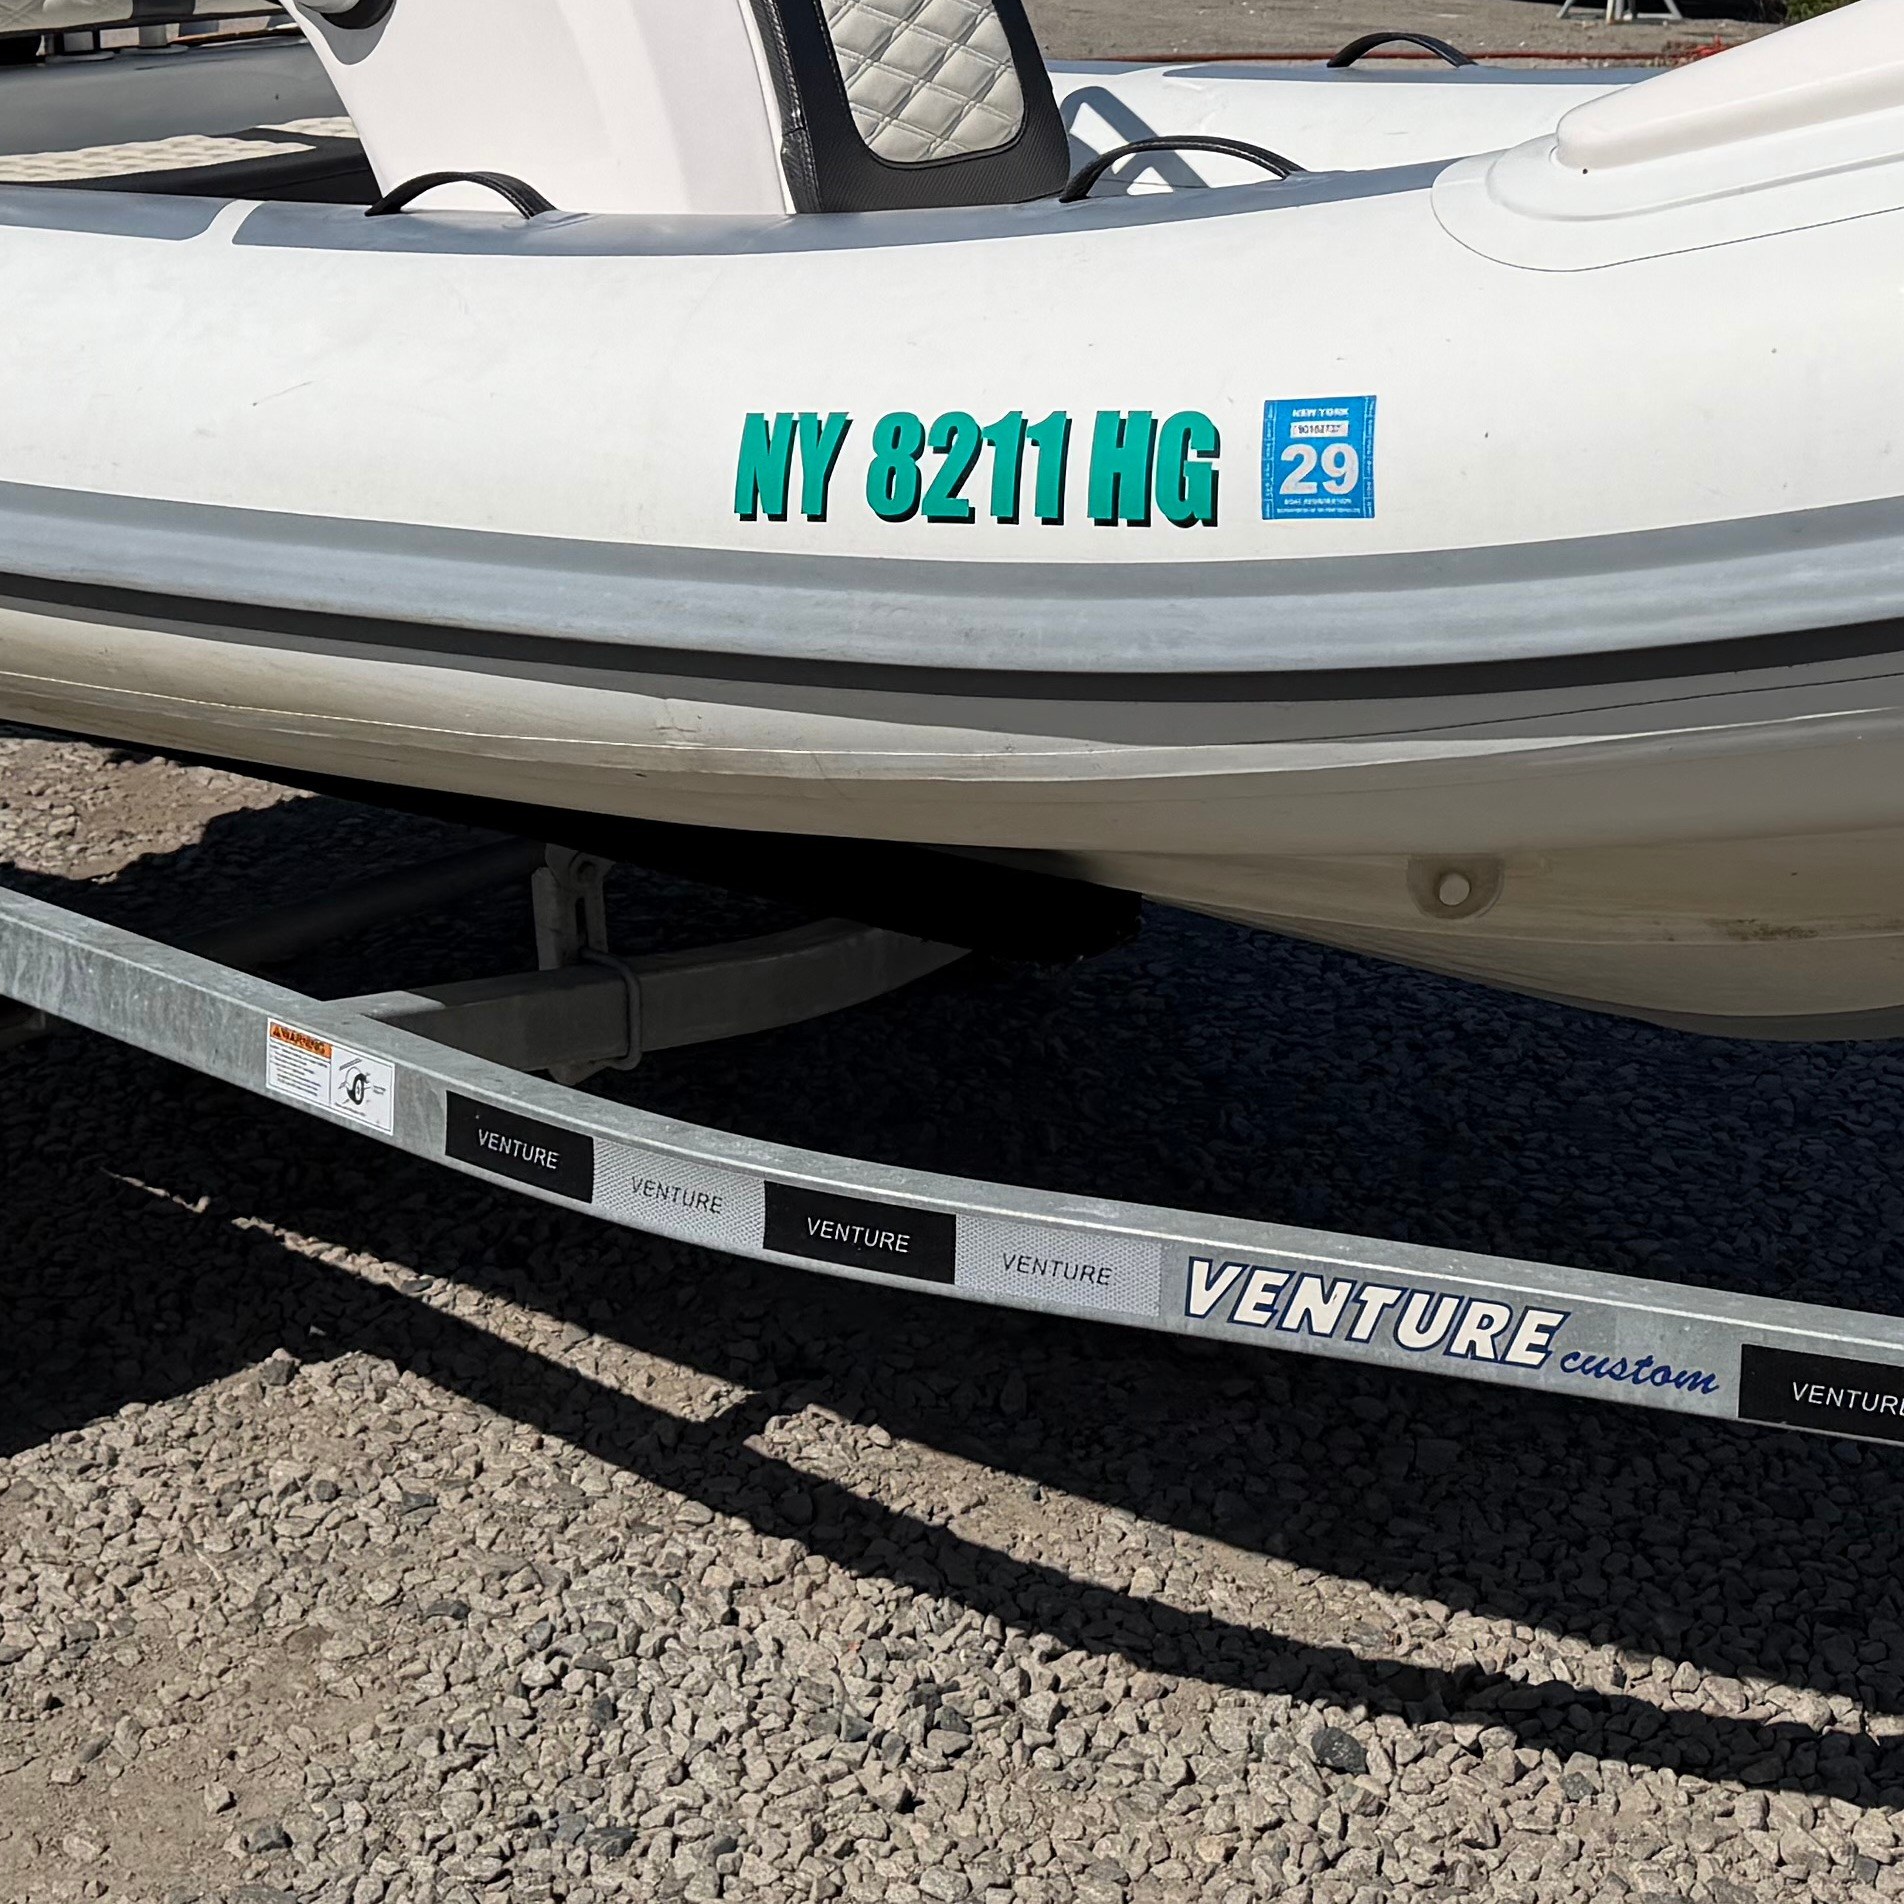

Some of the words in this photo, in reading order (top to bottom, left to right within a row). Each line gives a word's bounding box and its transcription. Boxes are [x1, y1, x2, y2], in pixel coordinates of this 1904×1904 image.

[733, 411, 854, 523] NY
[865, 410, 1073, 526] 8211
[1087, 410, 1222, 529] HG
[1279, 442, 1359, 495] 29
[478, 1128, 560, 1170] VENTURE
[632, 1176, 723, 1215] VENTURE
[807, 1216, 911, 1253] VENTURE
[1002, 1252, 1113, 1286] VENTURE
[1184, 1256, 1572, 1370] VENTURE
[1559, 1349, 1720, 1395] custom
